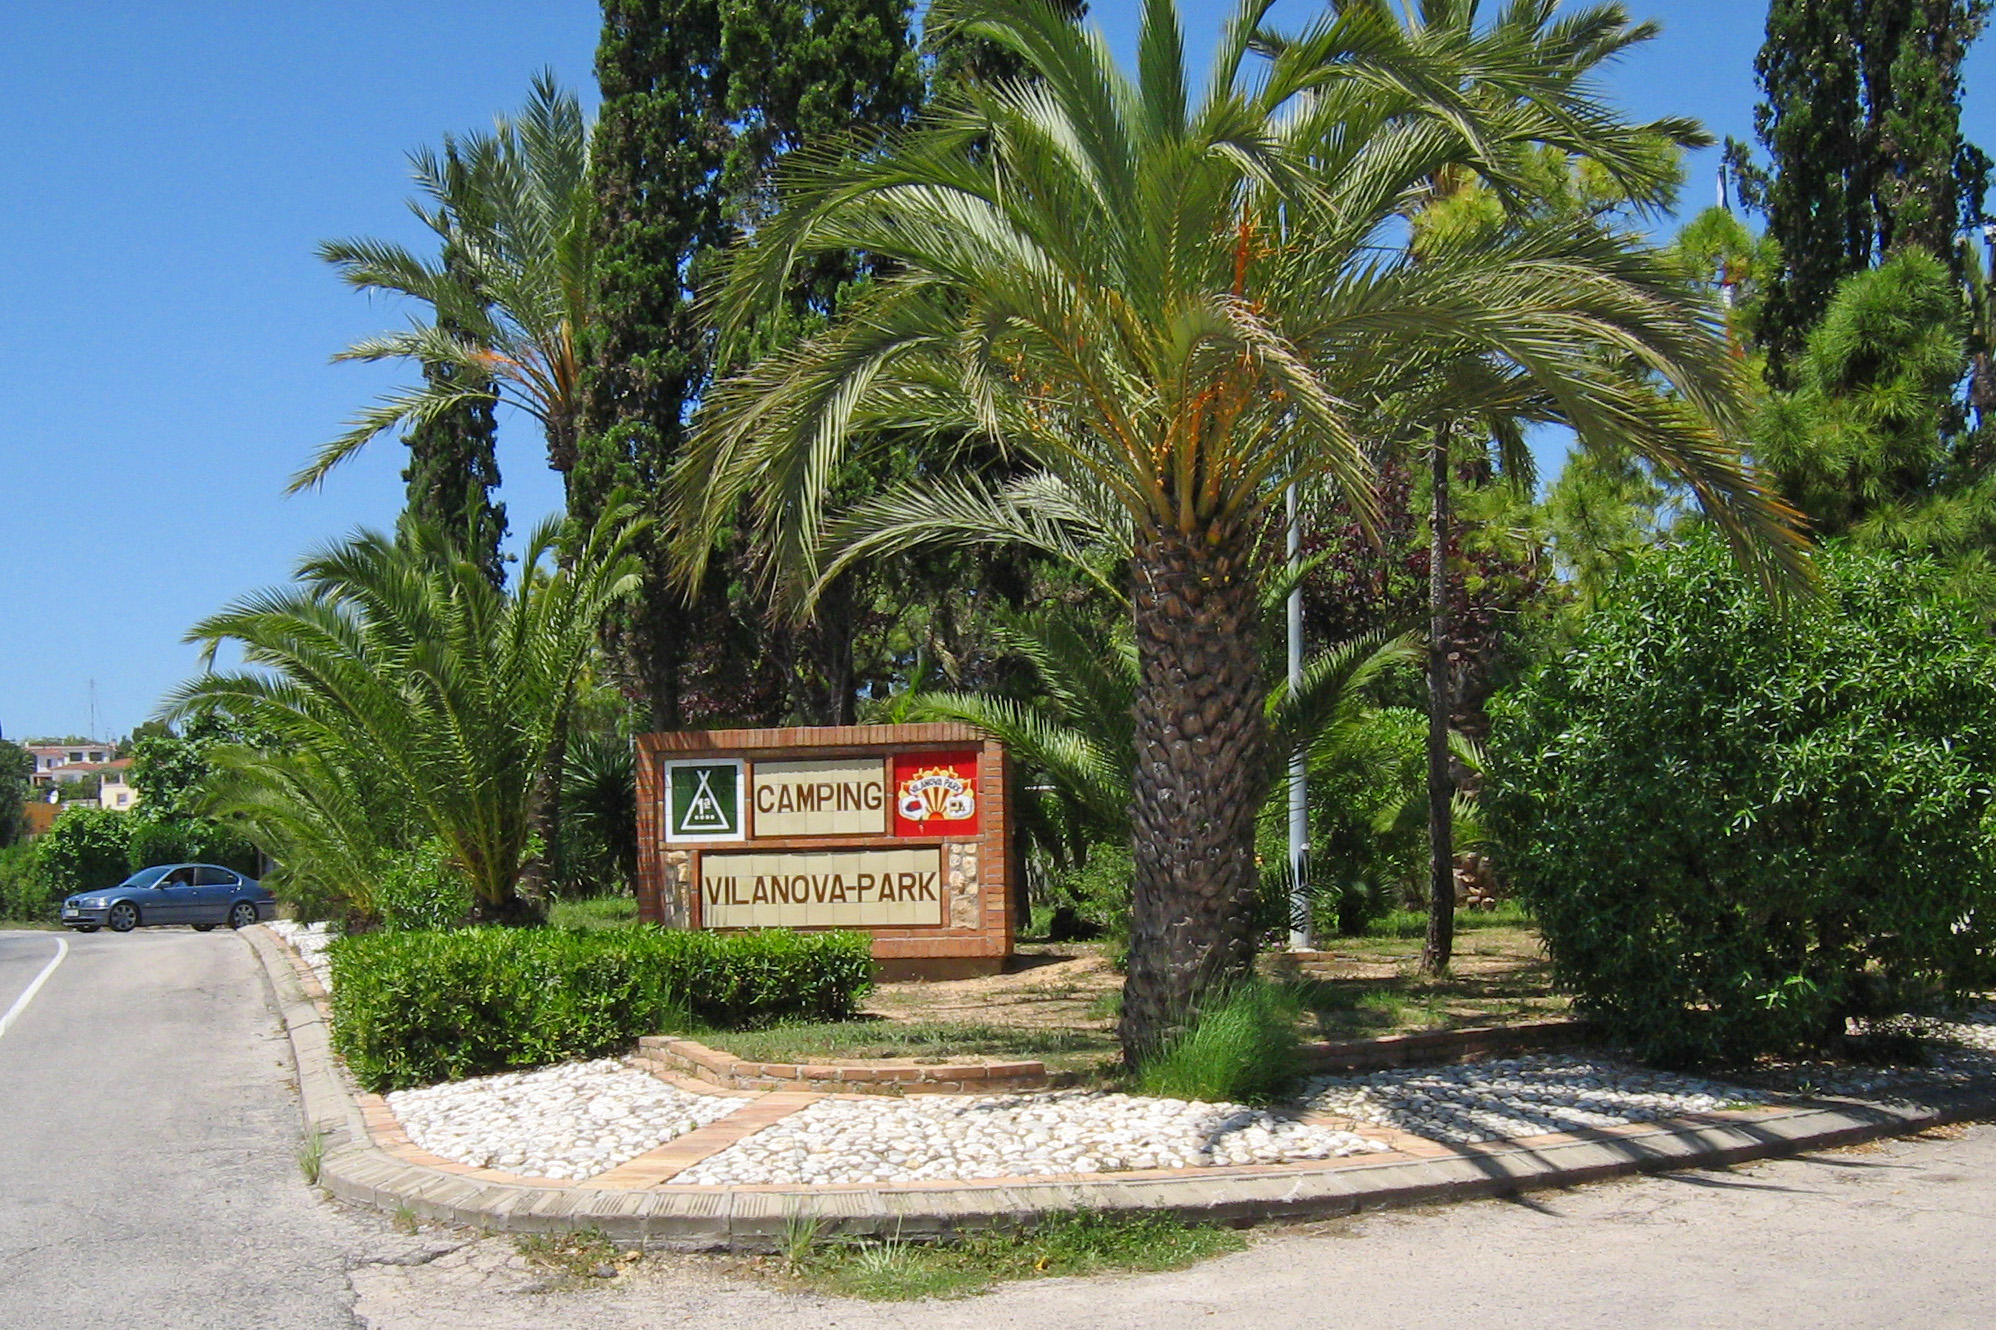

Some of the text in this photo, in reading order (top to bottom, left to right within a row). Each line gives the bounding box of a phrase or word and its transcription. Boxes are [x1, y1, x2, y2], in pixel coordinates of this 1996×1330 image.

[757, 782, 882, 813] CAMPING
[911, 778, 962, 793] VILANOVA PARK
[705, 872, 938, 905] VILANOVA-PARK
